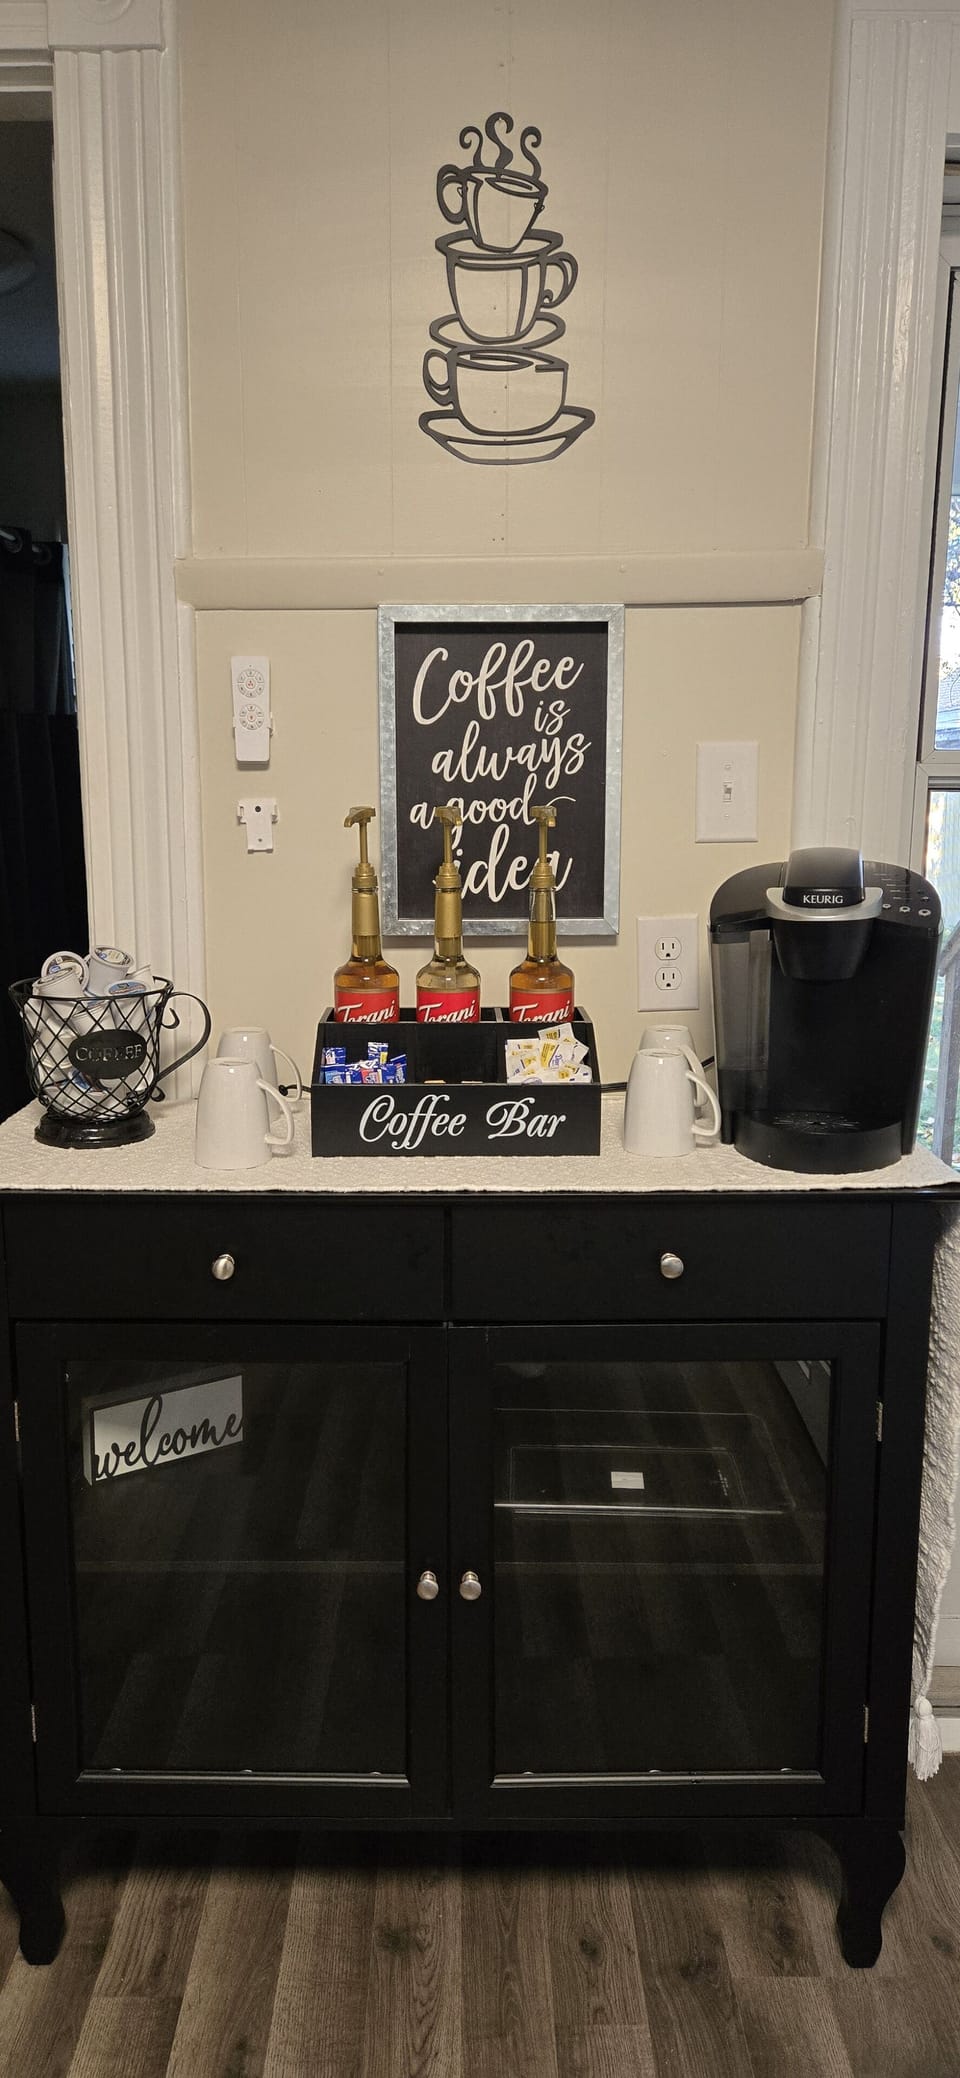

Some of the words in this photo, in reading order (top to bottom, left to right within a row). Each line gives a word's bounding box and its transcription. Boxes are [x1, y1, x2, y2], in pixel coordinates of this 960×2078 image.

[413, 640, 584, 725] Coffee
[534, 699, 571, 735] is
[432, 720, 592, 789] always
[409, 802, 436, 830] a
[446, 772, 576, 850] good
[803, 894, 844, 904] KEURIG
[358, 1094, 467, 1150] Coffee
[485, 1097, 567, 1140] Bar
[94, 1394, 243, 1478] welcome
